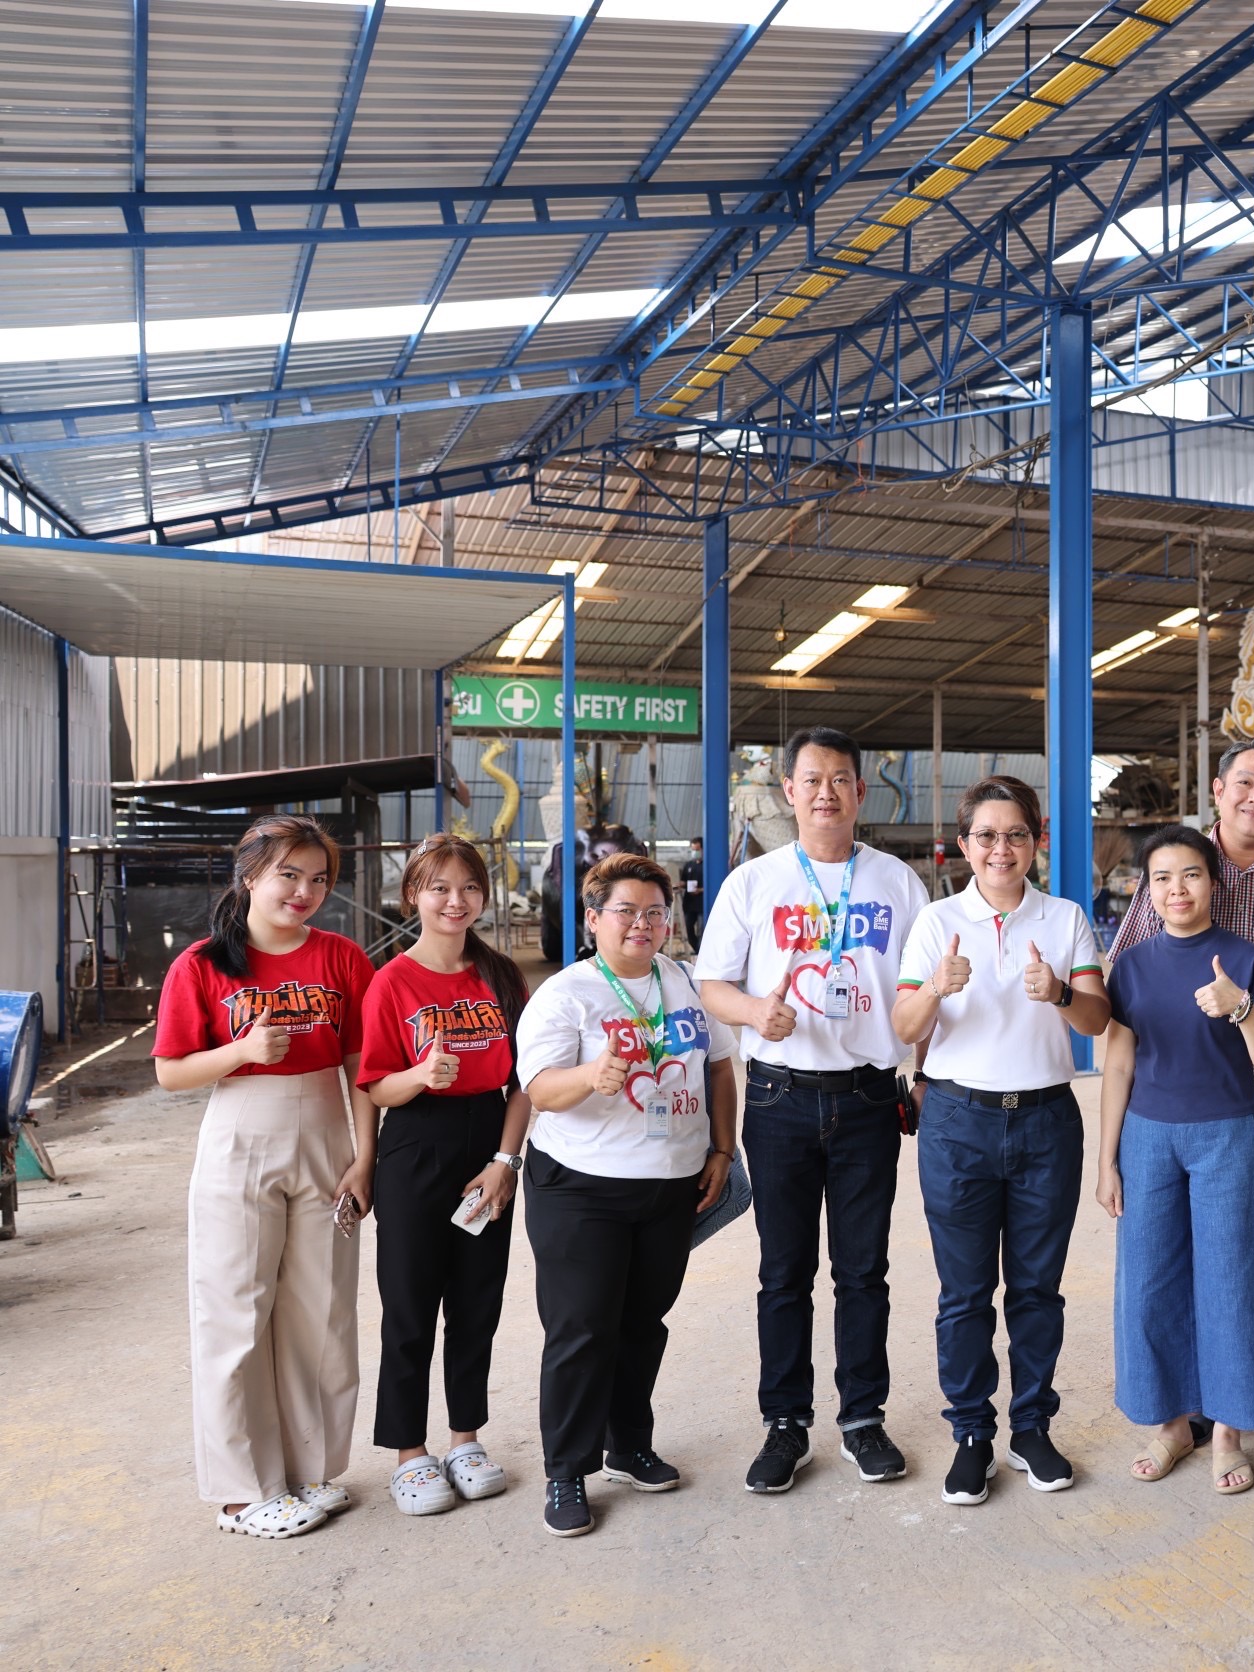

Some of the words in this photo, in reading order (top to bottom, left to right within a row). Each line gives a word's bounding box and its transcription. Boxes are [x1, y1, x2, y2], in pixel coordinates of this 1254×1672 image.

[634, 696, 687, 722] FIRST
[850, 913, 870, 939] D
[674, 1020, 697, 1043] D
